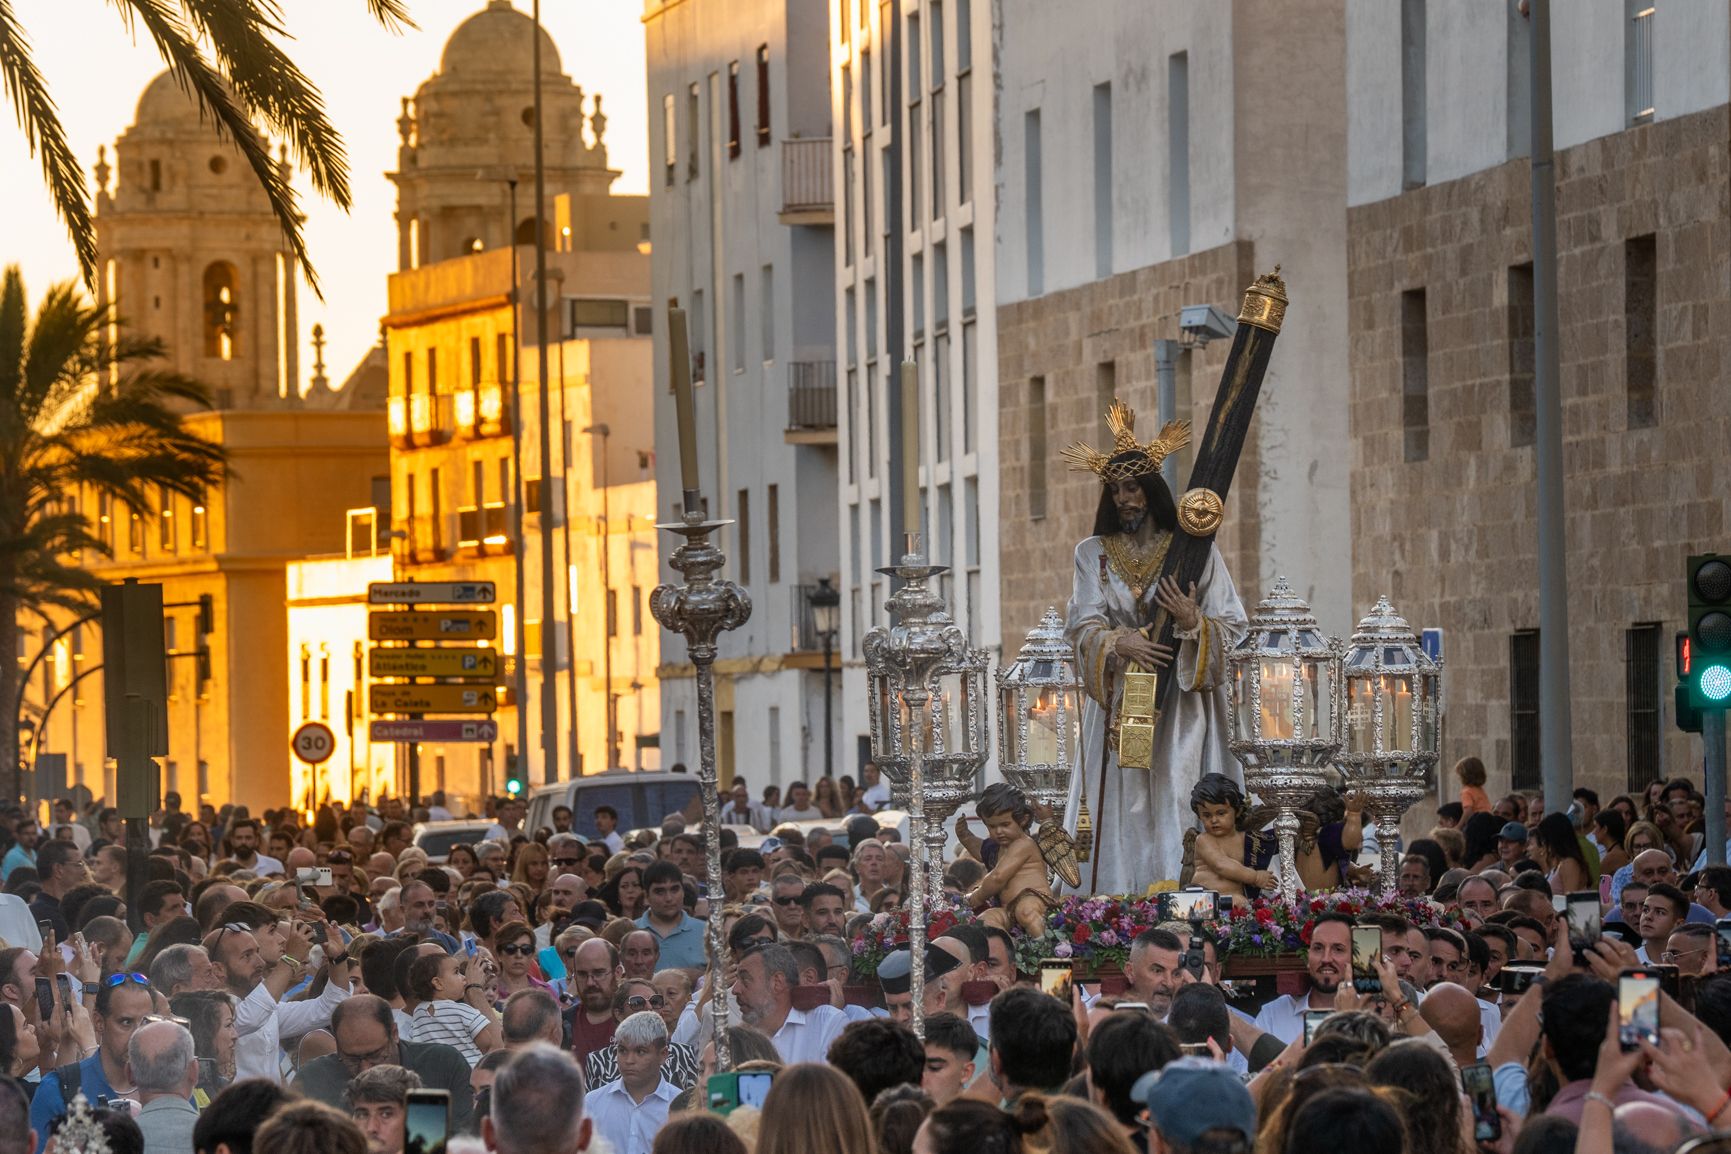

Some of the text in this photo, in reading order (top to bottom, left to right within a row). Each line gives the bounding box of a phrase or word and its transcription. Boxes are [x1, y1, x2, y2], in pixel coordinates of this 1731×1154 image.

[373, 588, 421, 598] Mercado
[375, 698, 431, 708] La Caleta
[374, 726, 424, 737] Catedral
[302, 736, 326, 750] 30
